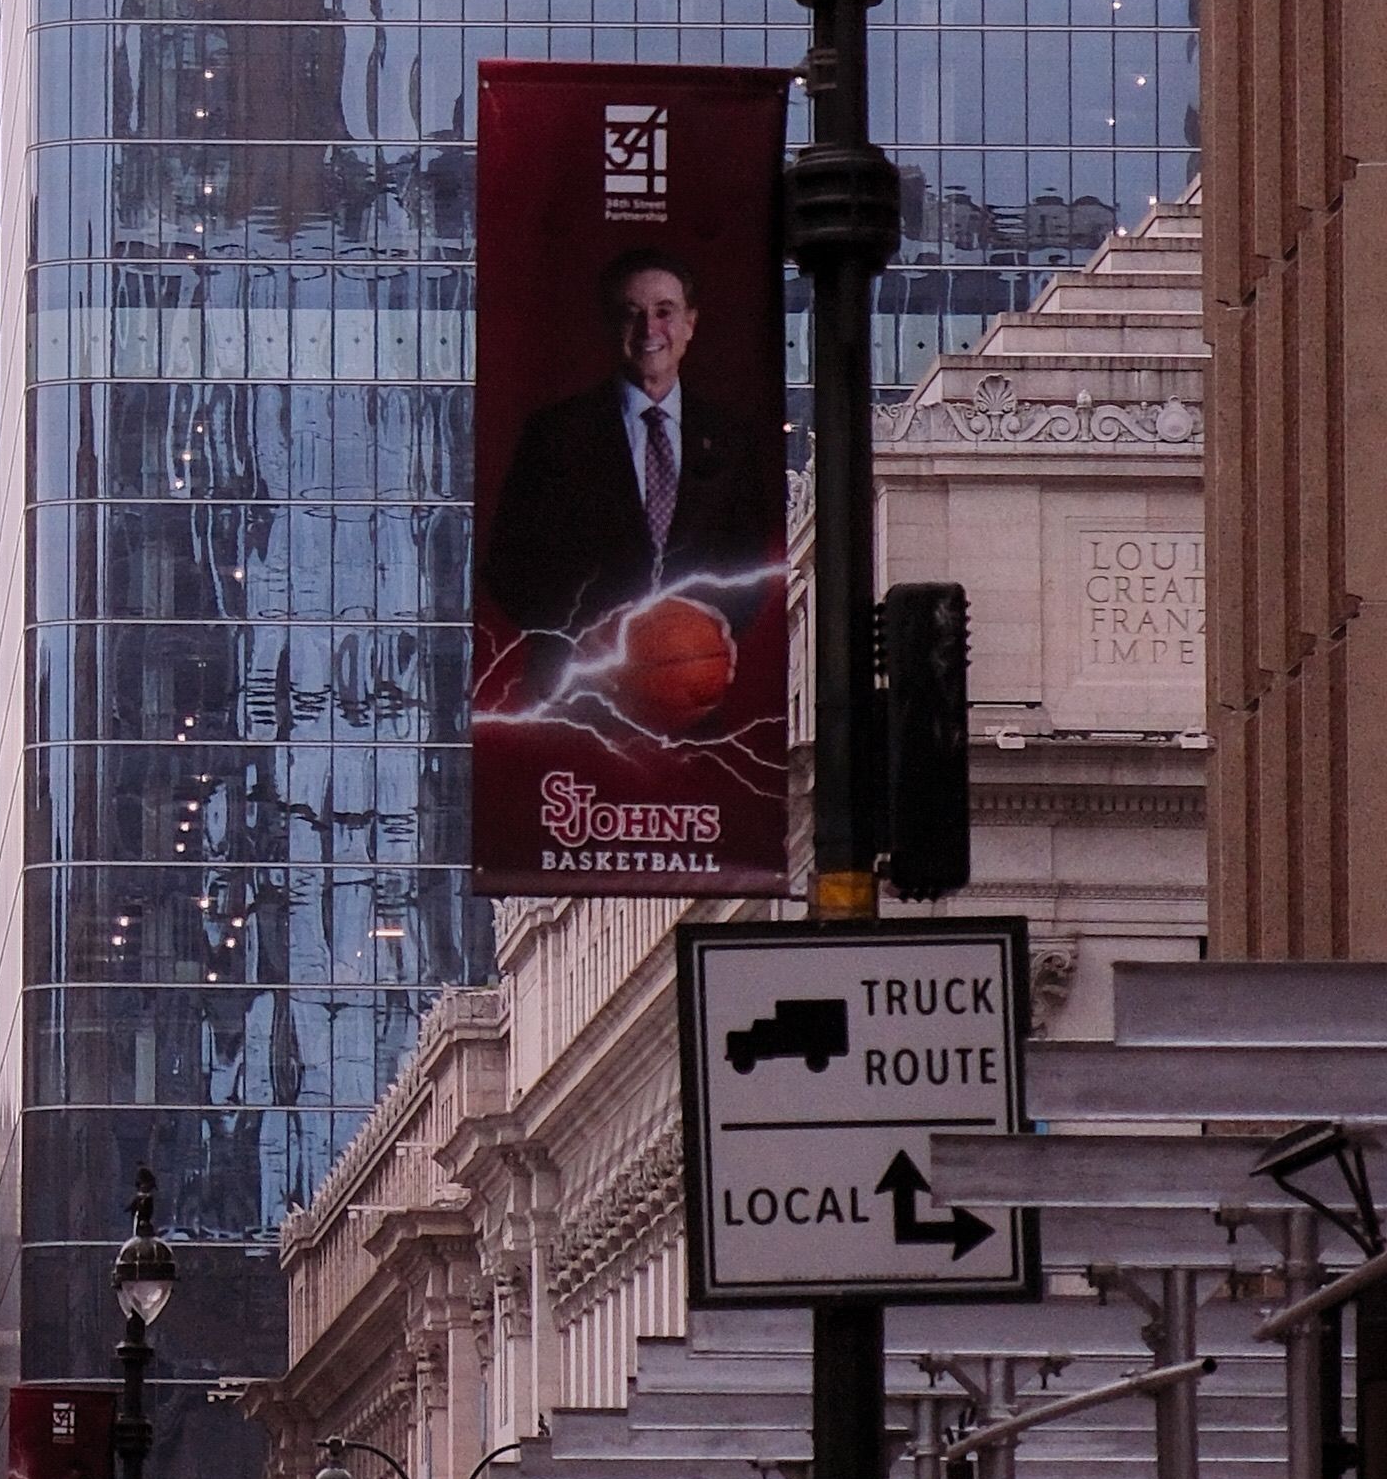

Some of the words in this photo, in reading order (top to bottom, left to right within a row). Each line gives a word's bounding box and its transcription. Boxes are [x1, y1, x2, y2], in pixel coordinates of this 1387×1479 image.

[633, 198, 667, 211] Street
[1090, 541, 1202, 571] LOUI
[1086, 575, 1206, 603] CREAT
[1091, 639, 1194, 665] IMPE
[540, 850, 722, 873] BASKETBALL
[859, 977, 995, 1017] TRUCK
[866, 1047, 998, 1086] ROUTE
[725, 1186, 870, 1227] LOCAL
